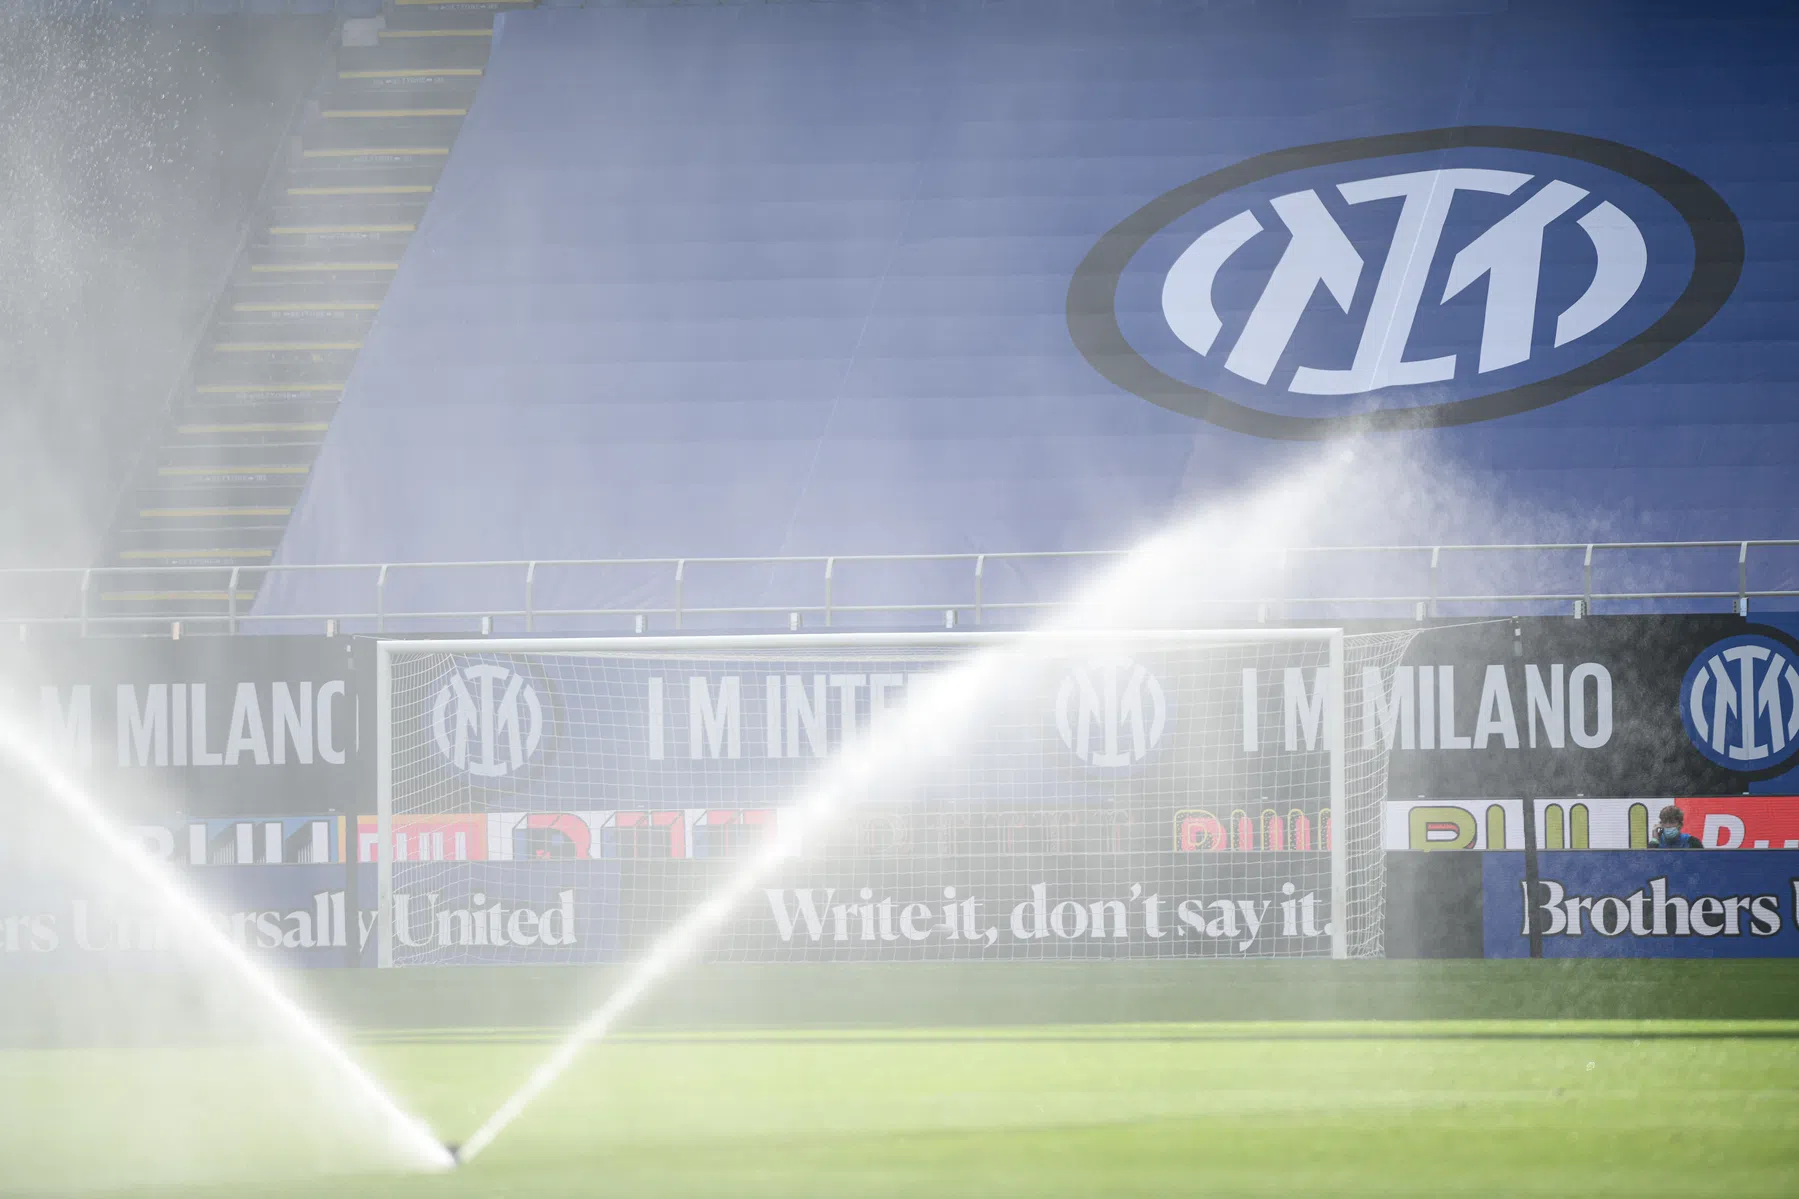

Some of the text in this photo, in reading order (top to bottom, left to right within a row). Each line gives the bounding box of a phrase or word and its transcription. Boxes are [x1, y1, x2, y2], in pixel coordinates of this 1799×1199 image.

[648, 677, 664, 760] I
[690, 676, 741, 759] M
[1242, 662, 1613, 752] I M MILANO
[393, 889, 577, 948] United
[764, 886, 933, 942] Write
[943, 885, 999, 949] it,
[1177, 898, 1272, 952] say
[1521, 876, 1782, 937] Brothers
